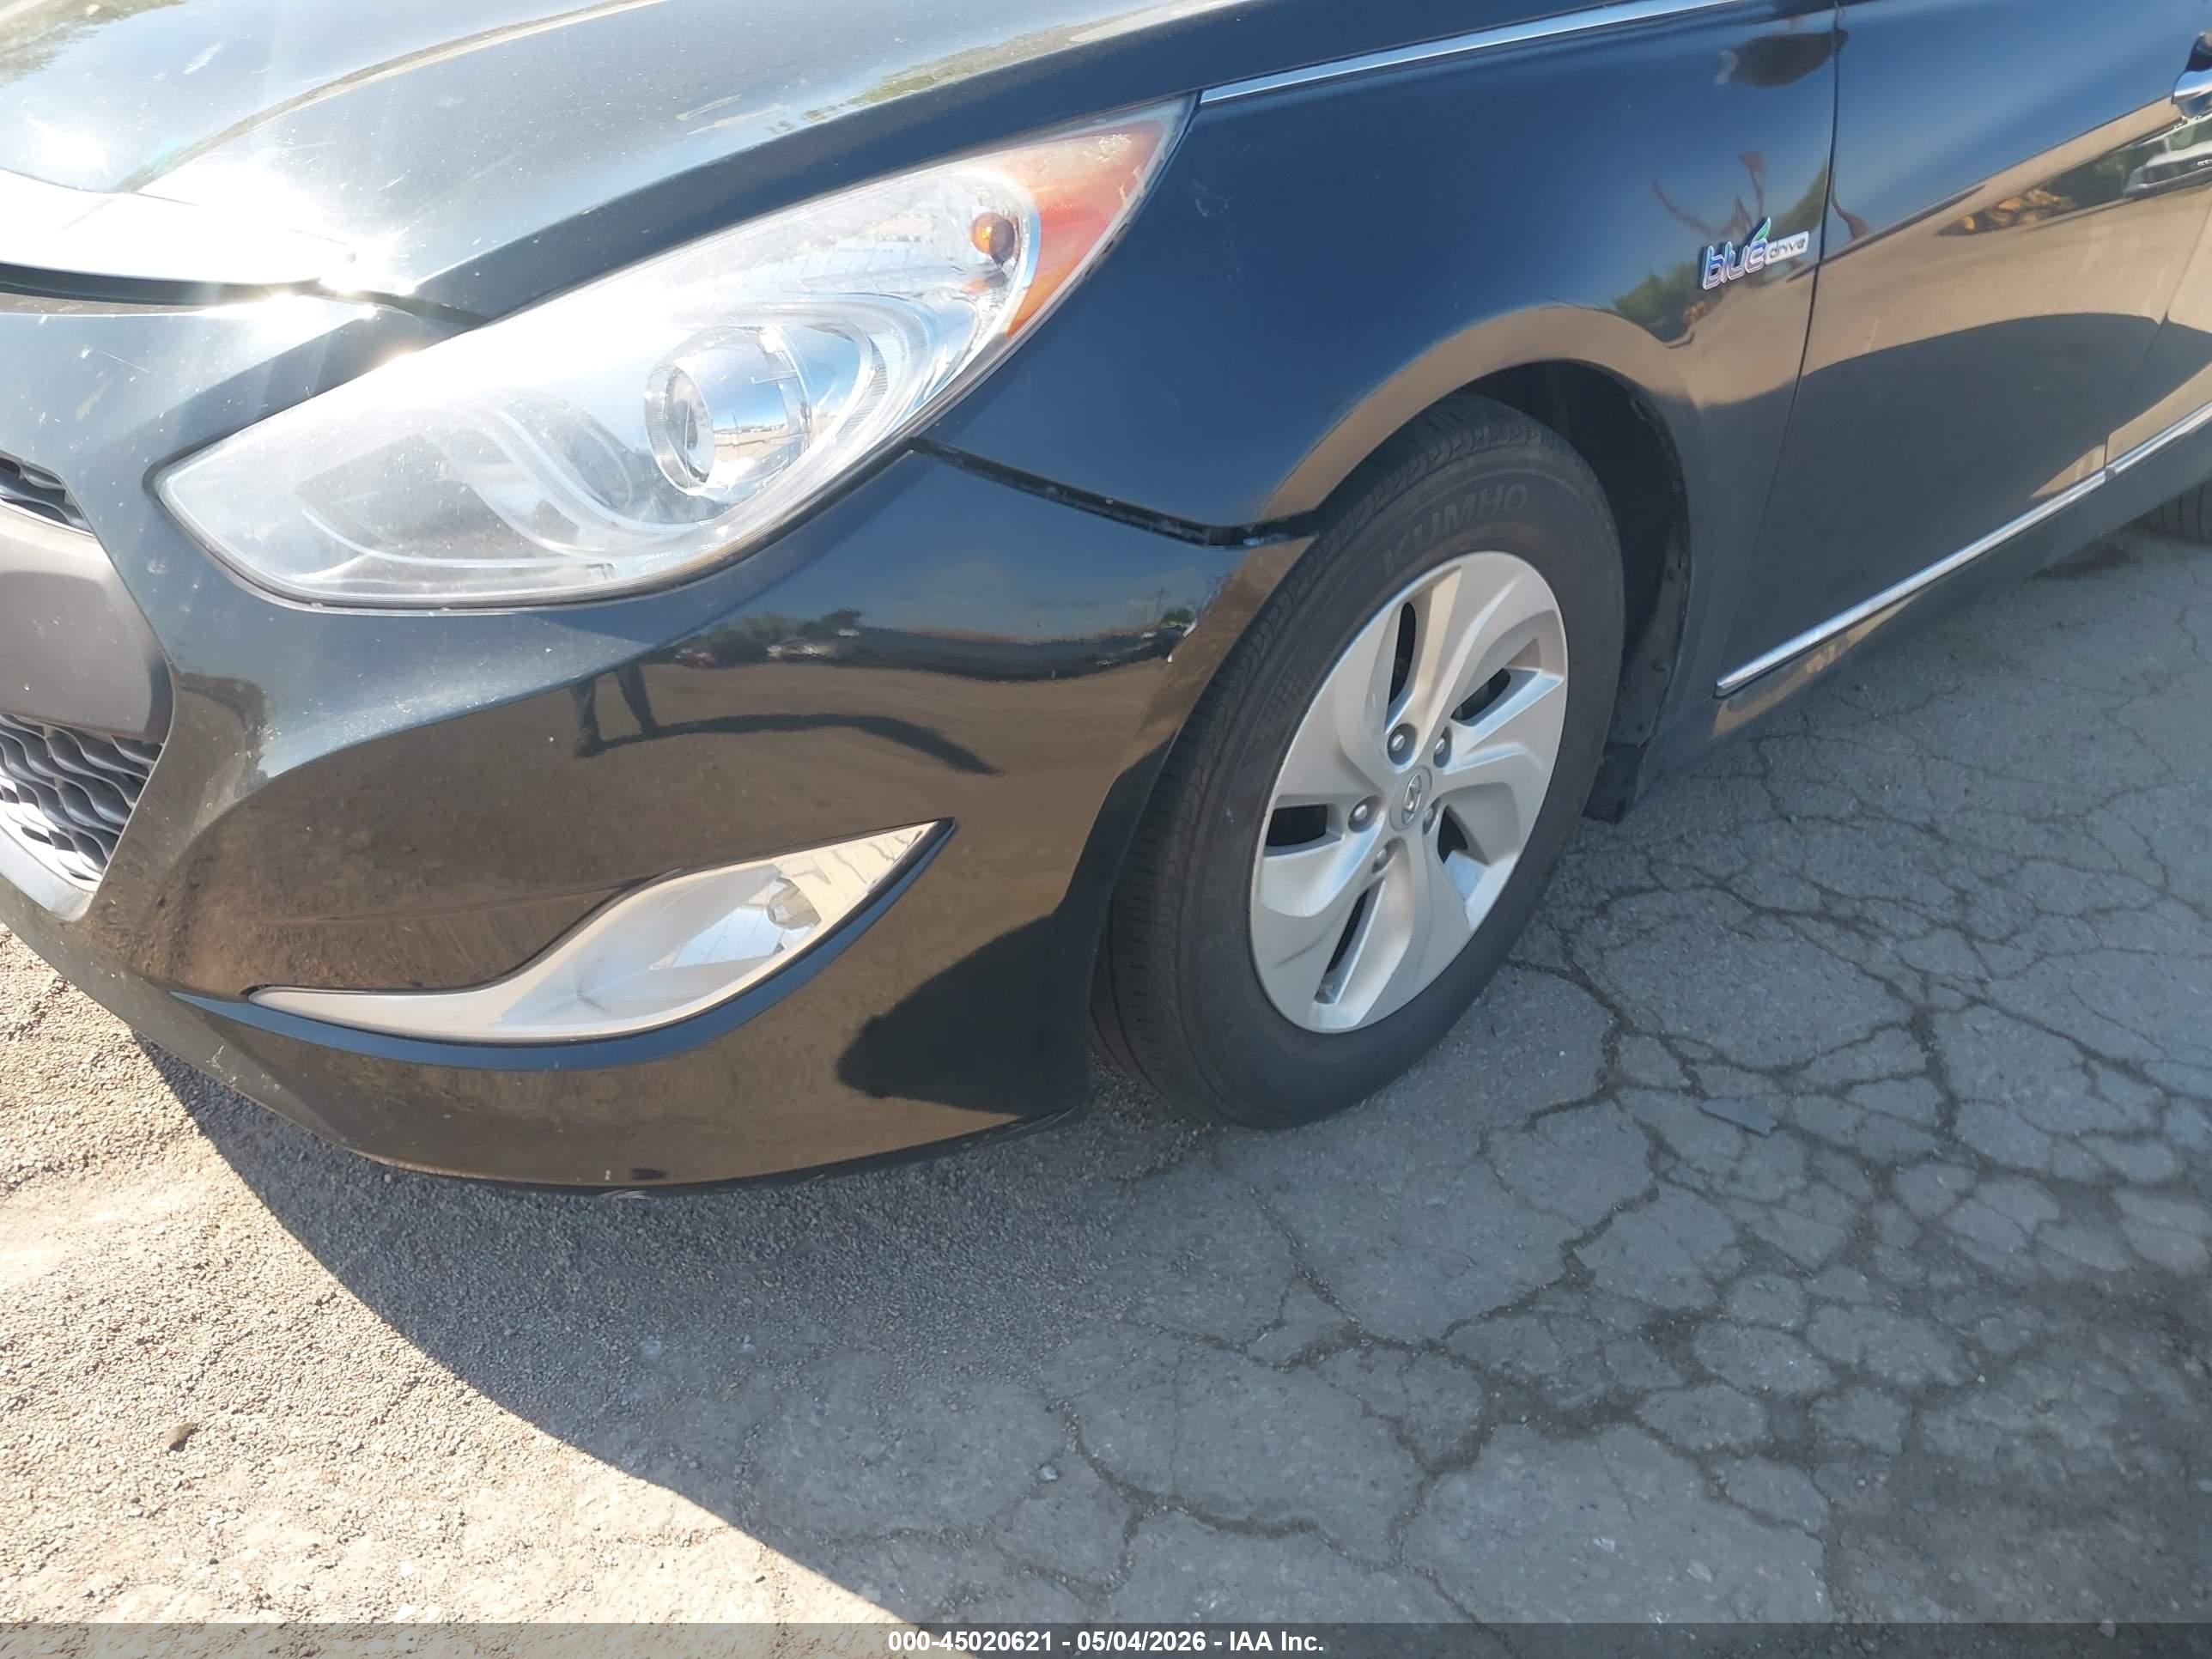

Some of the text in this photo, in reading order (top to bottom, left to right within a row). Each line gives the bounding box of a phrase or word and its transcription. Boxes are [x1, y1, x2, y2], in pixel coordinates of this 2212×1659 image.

[1703, 237, 1807, 290] blue drive
[1382, 482, 1528, 577] KUMHO
